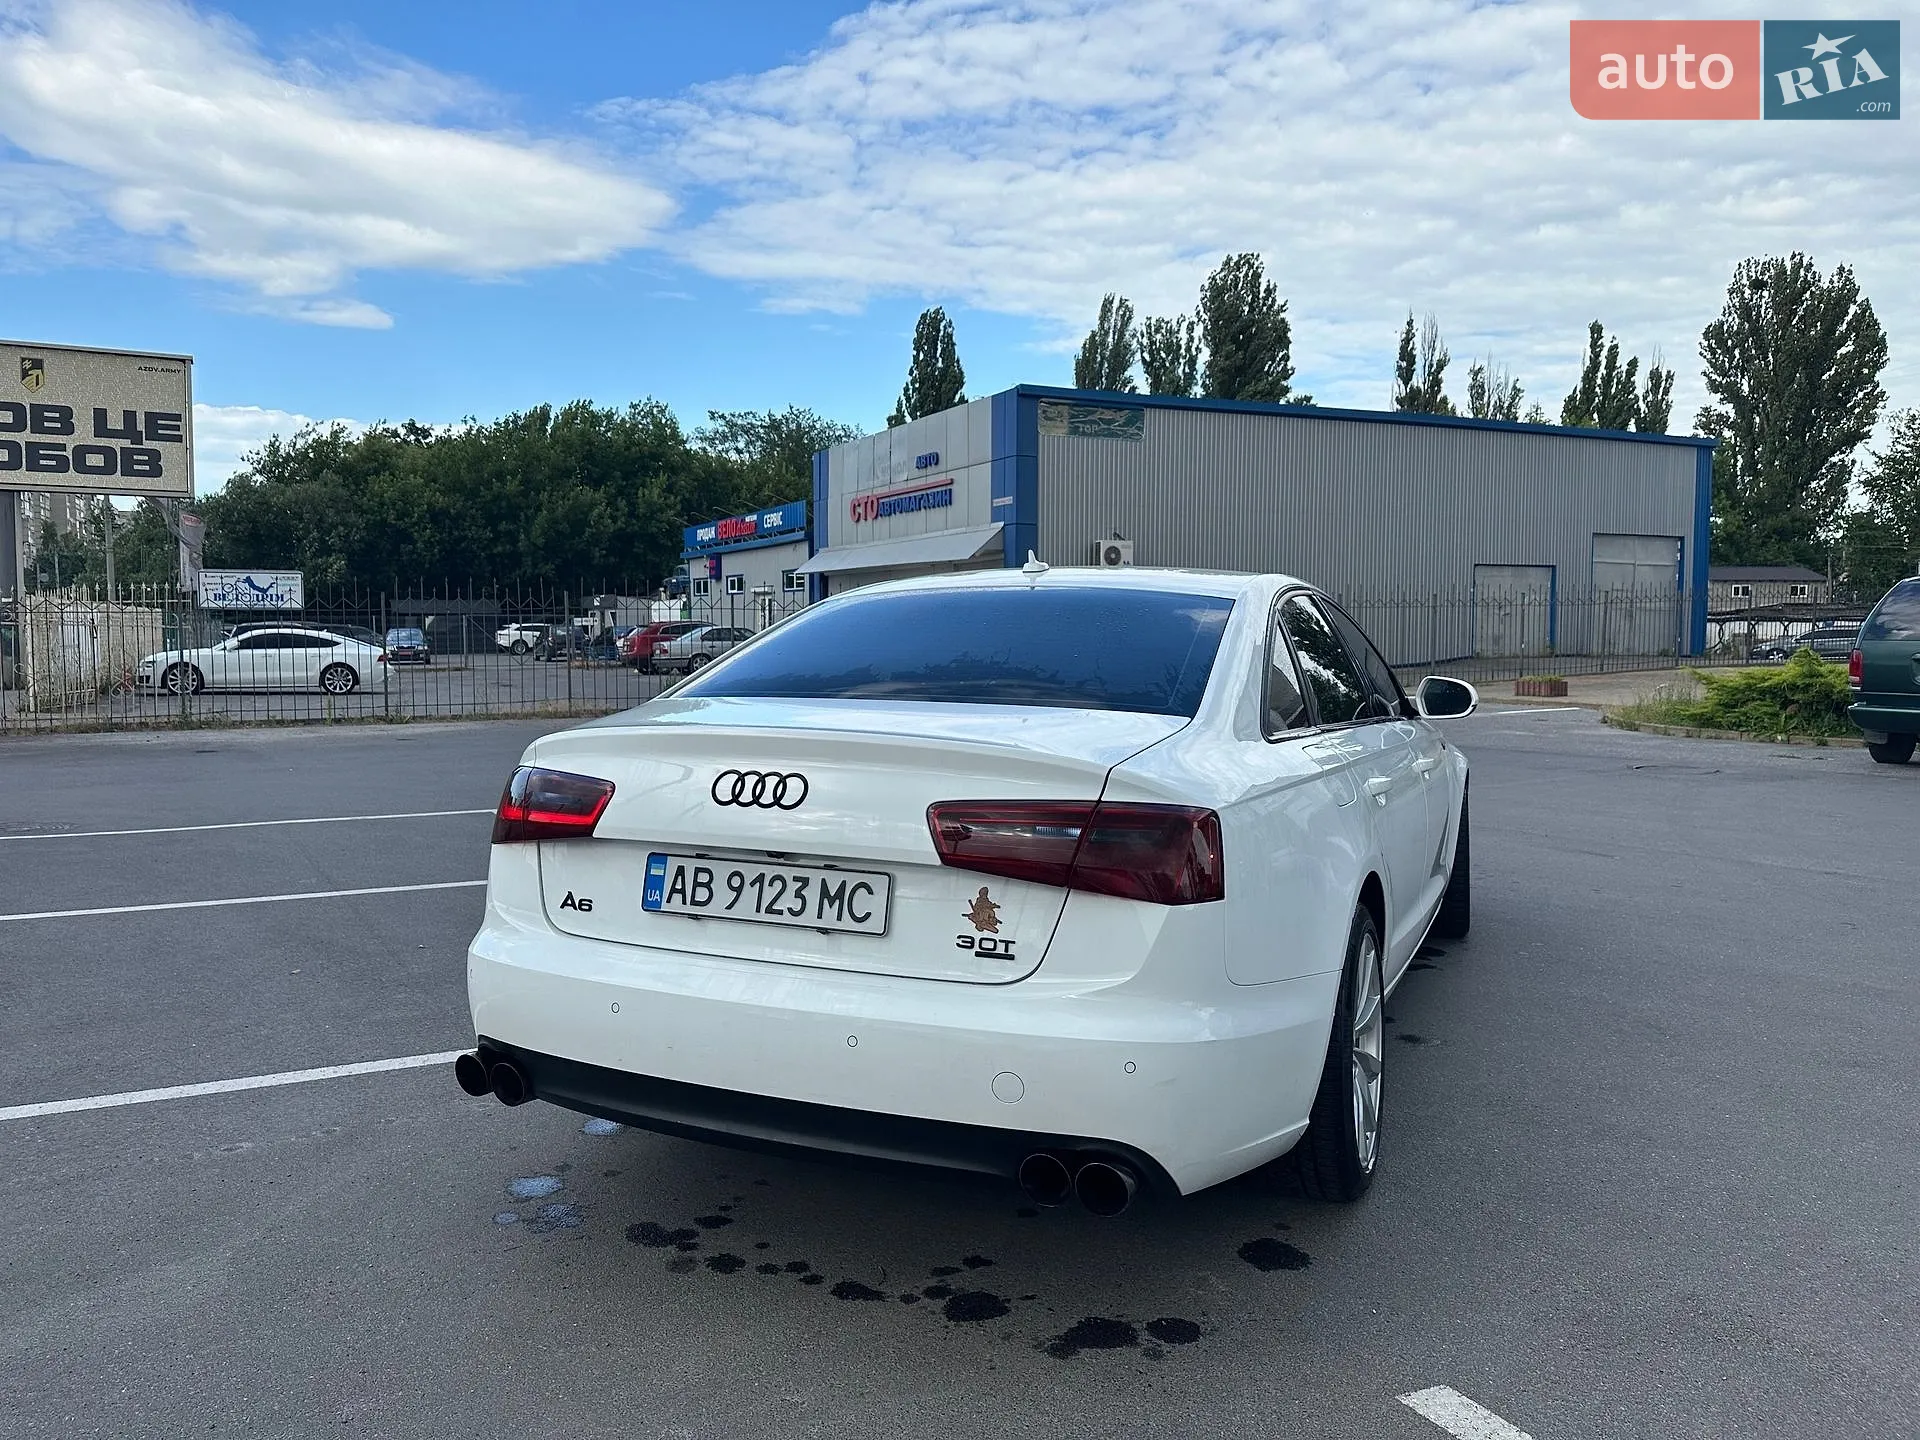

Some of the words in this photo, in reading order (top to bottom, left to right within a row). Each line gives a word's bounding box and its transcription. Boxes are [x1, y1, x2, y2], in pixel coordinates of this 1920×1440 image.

[137, 365, 182, 375] AZOV.ARMY
[93, 407, 183, 445] ЦЕ
[915, 452, 939, 470] АВТО
[850, 495, 880, 523] СТО
[879, 488, 953, 517] АВТОМАГАЗИН
[763, 511, 783, 529] СЕРВІС
[560, 890, 593, 912] A6
[647, 889, 661, 902] UA
[665, 864, 714, 907] AB
[724, 870, 807, 918] 9123
[816, 875, 875, 924] MC
